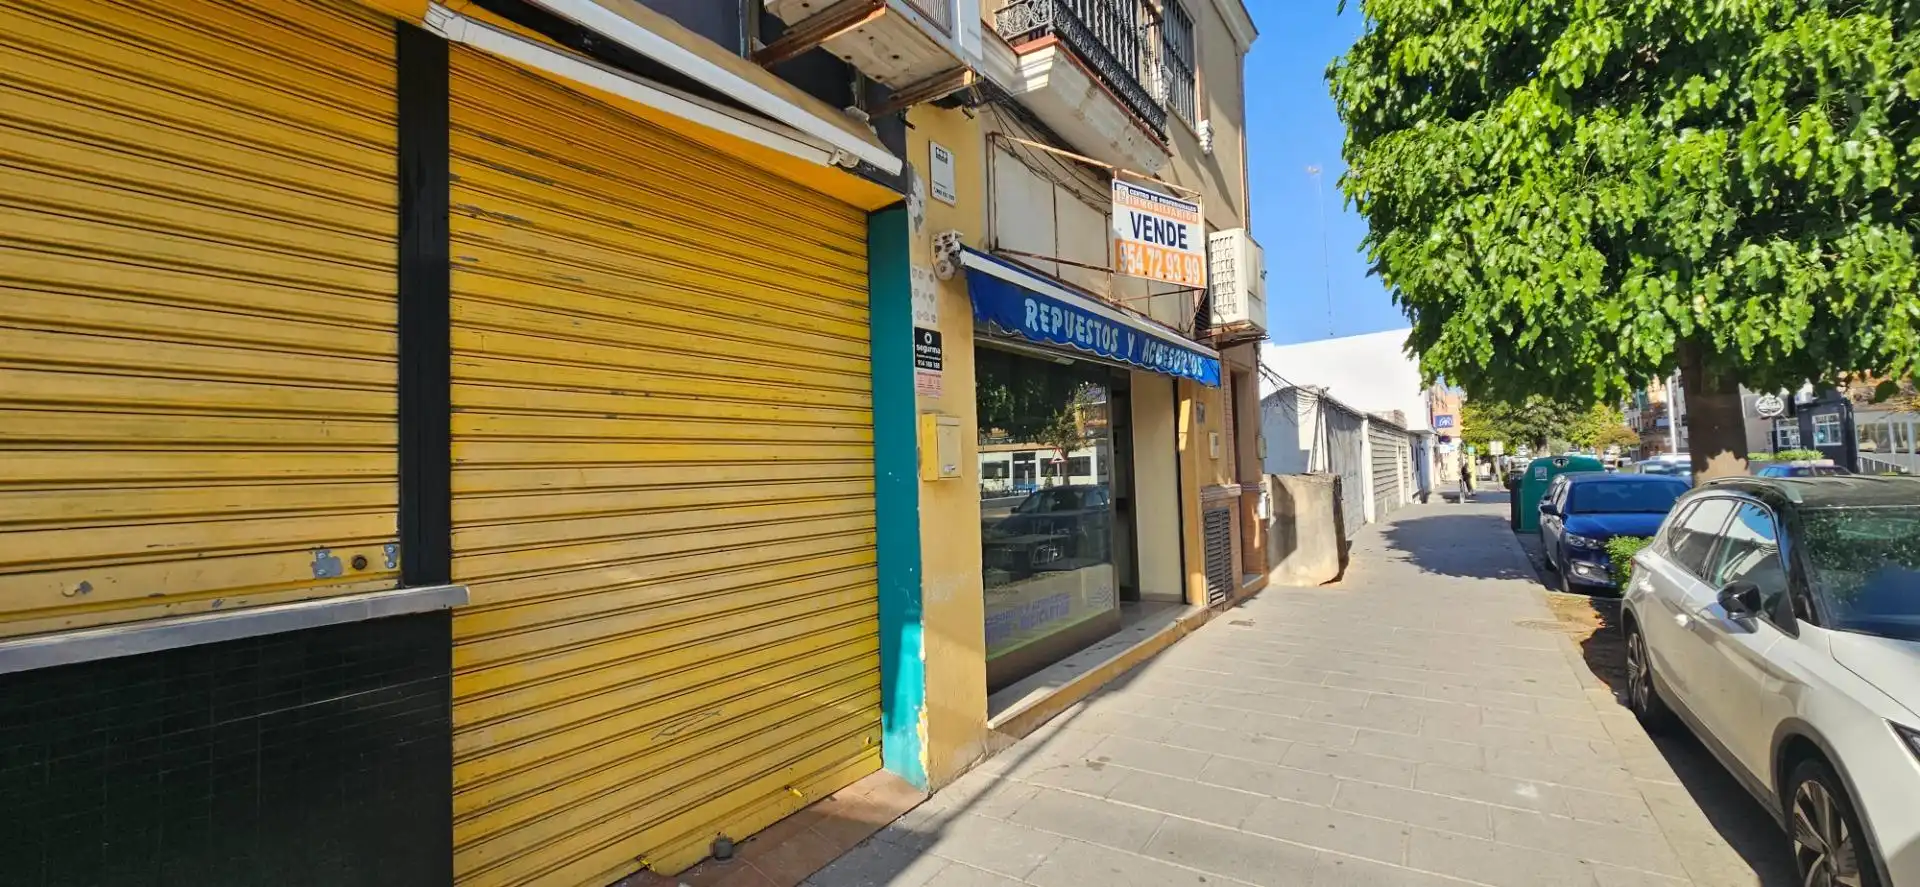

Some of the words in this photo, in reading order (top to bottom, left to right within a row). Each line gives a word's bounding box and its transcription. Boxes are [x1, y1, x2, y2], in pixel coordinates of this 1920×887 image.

[1130, 211, 1188, 249] VENDE
[1024, 298, 1118, 353] REPUESTOS
[1127, 332, 1135, 358] Y
